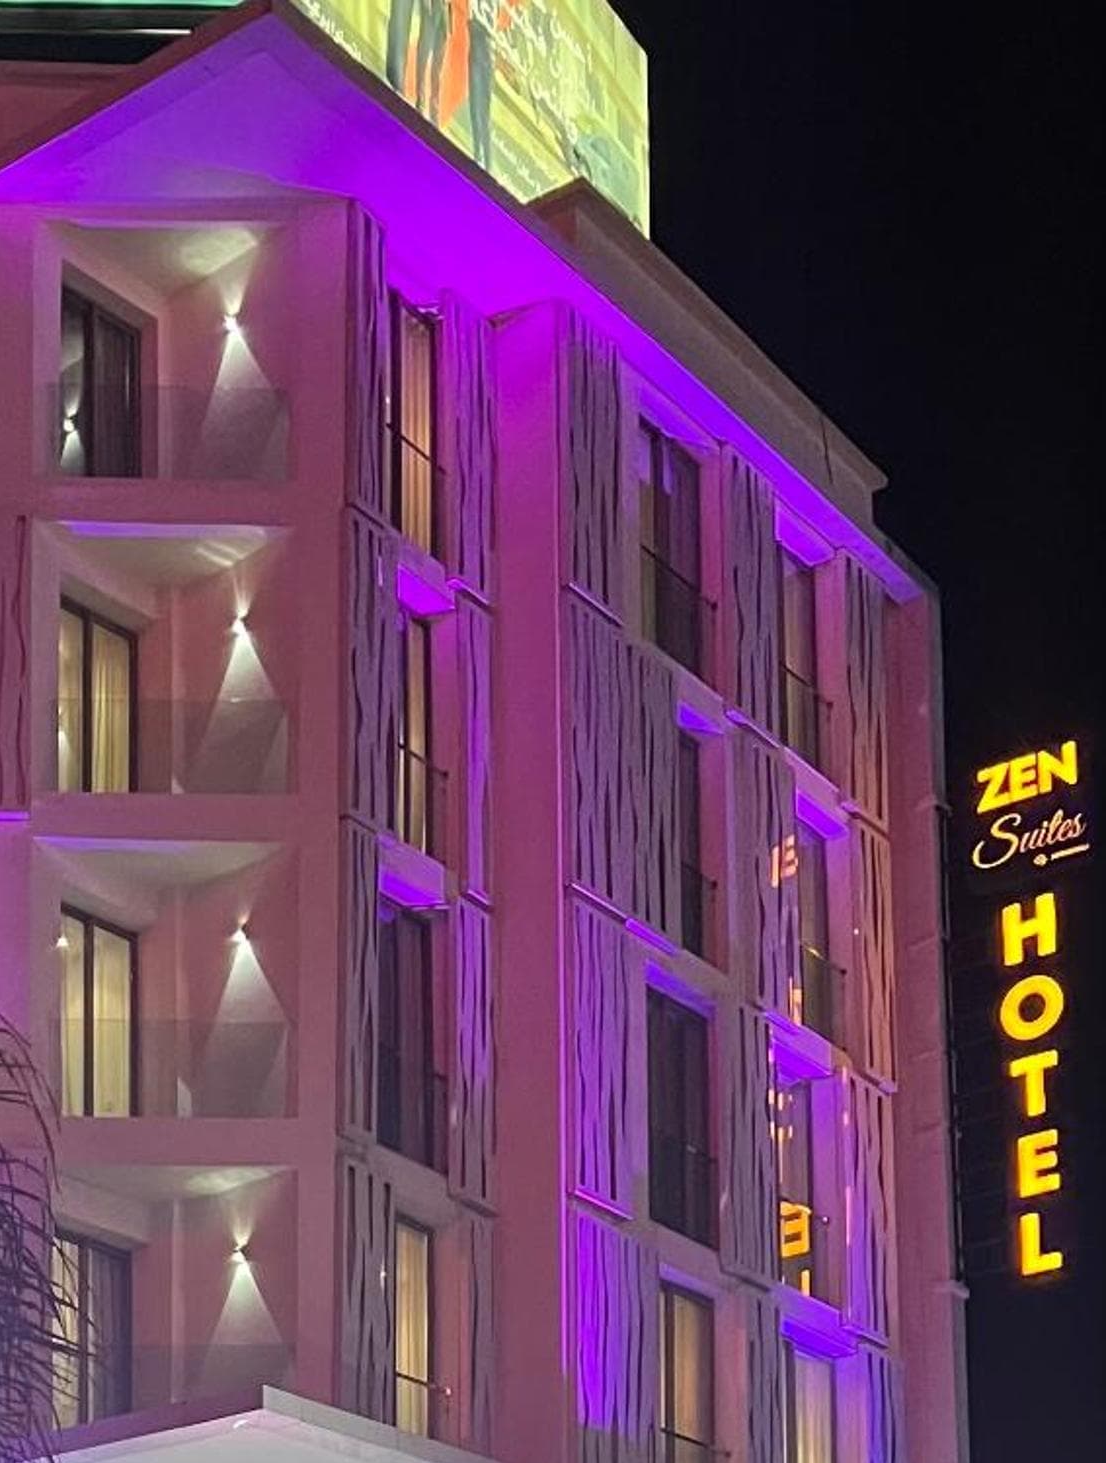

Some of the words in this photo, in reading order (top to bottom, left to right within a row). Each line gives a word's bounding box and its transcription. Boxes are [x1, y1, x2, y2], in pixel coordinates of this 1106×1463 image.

[977, 741, 1077, 813] ZEN
[973, 809, 1086, 868] Suites
[999, 893, 1063, 1278] HOTEL
